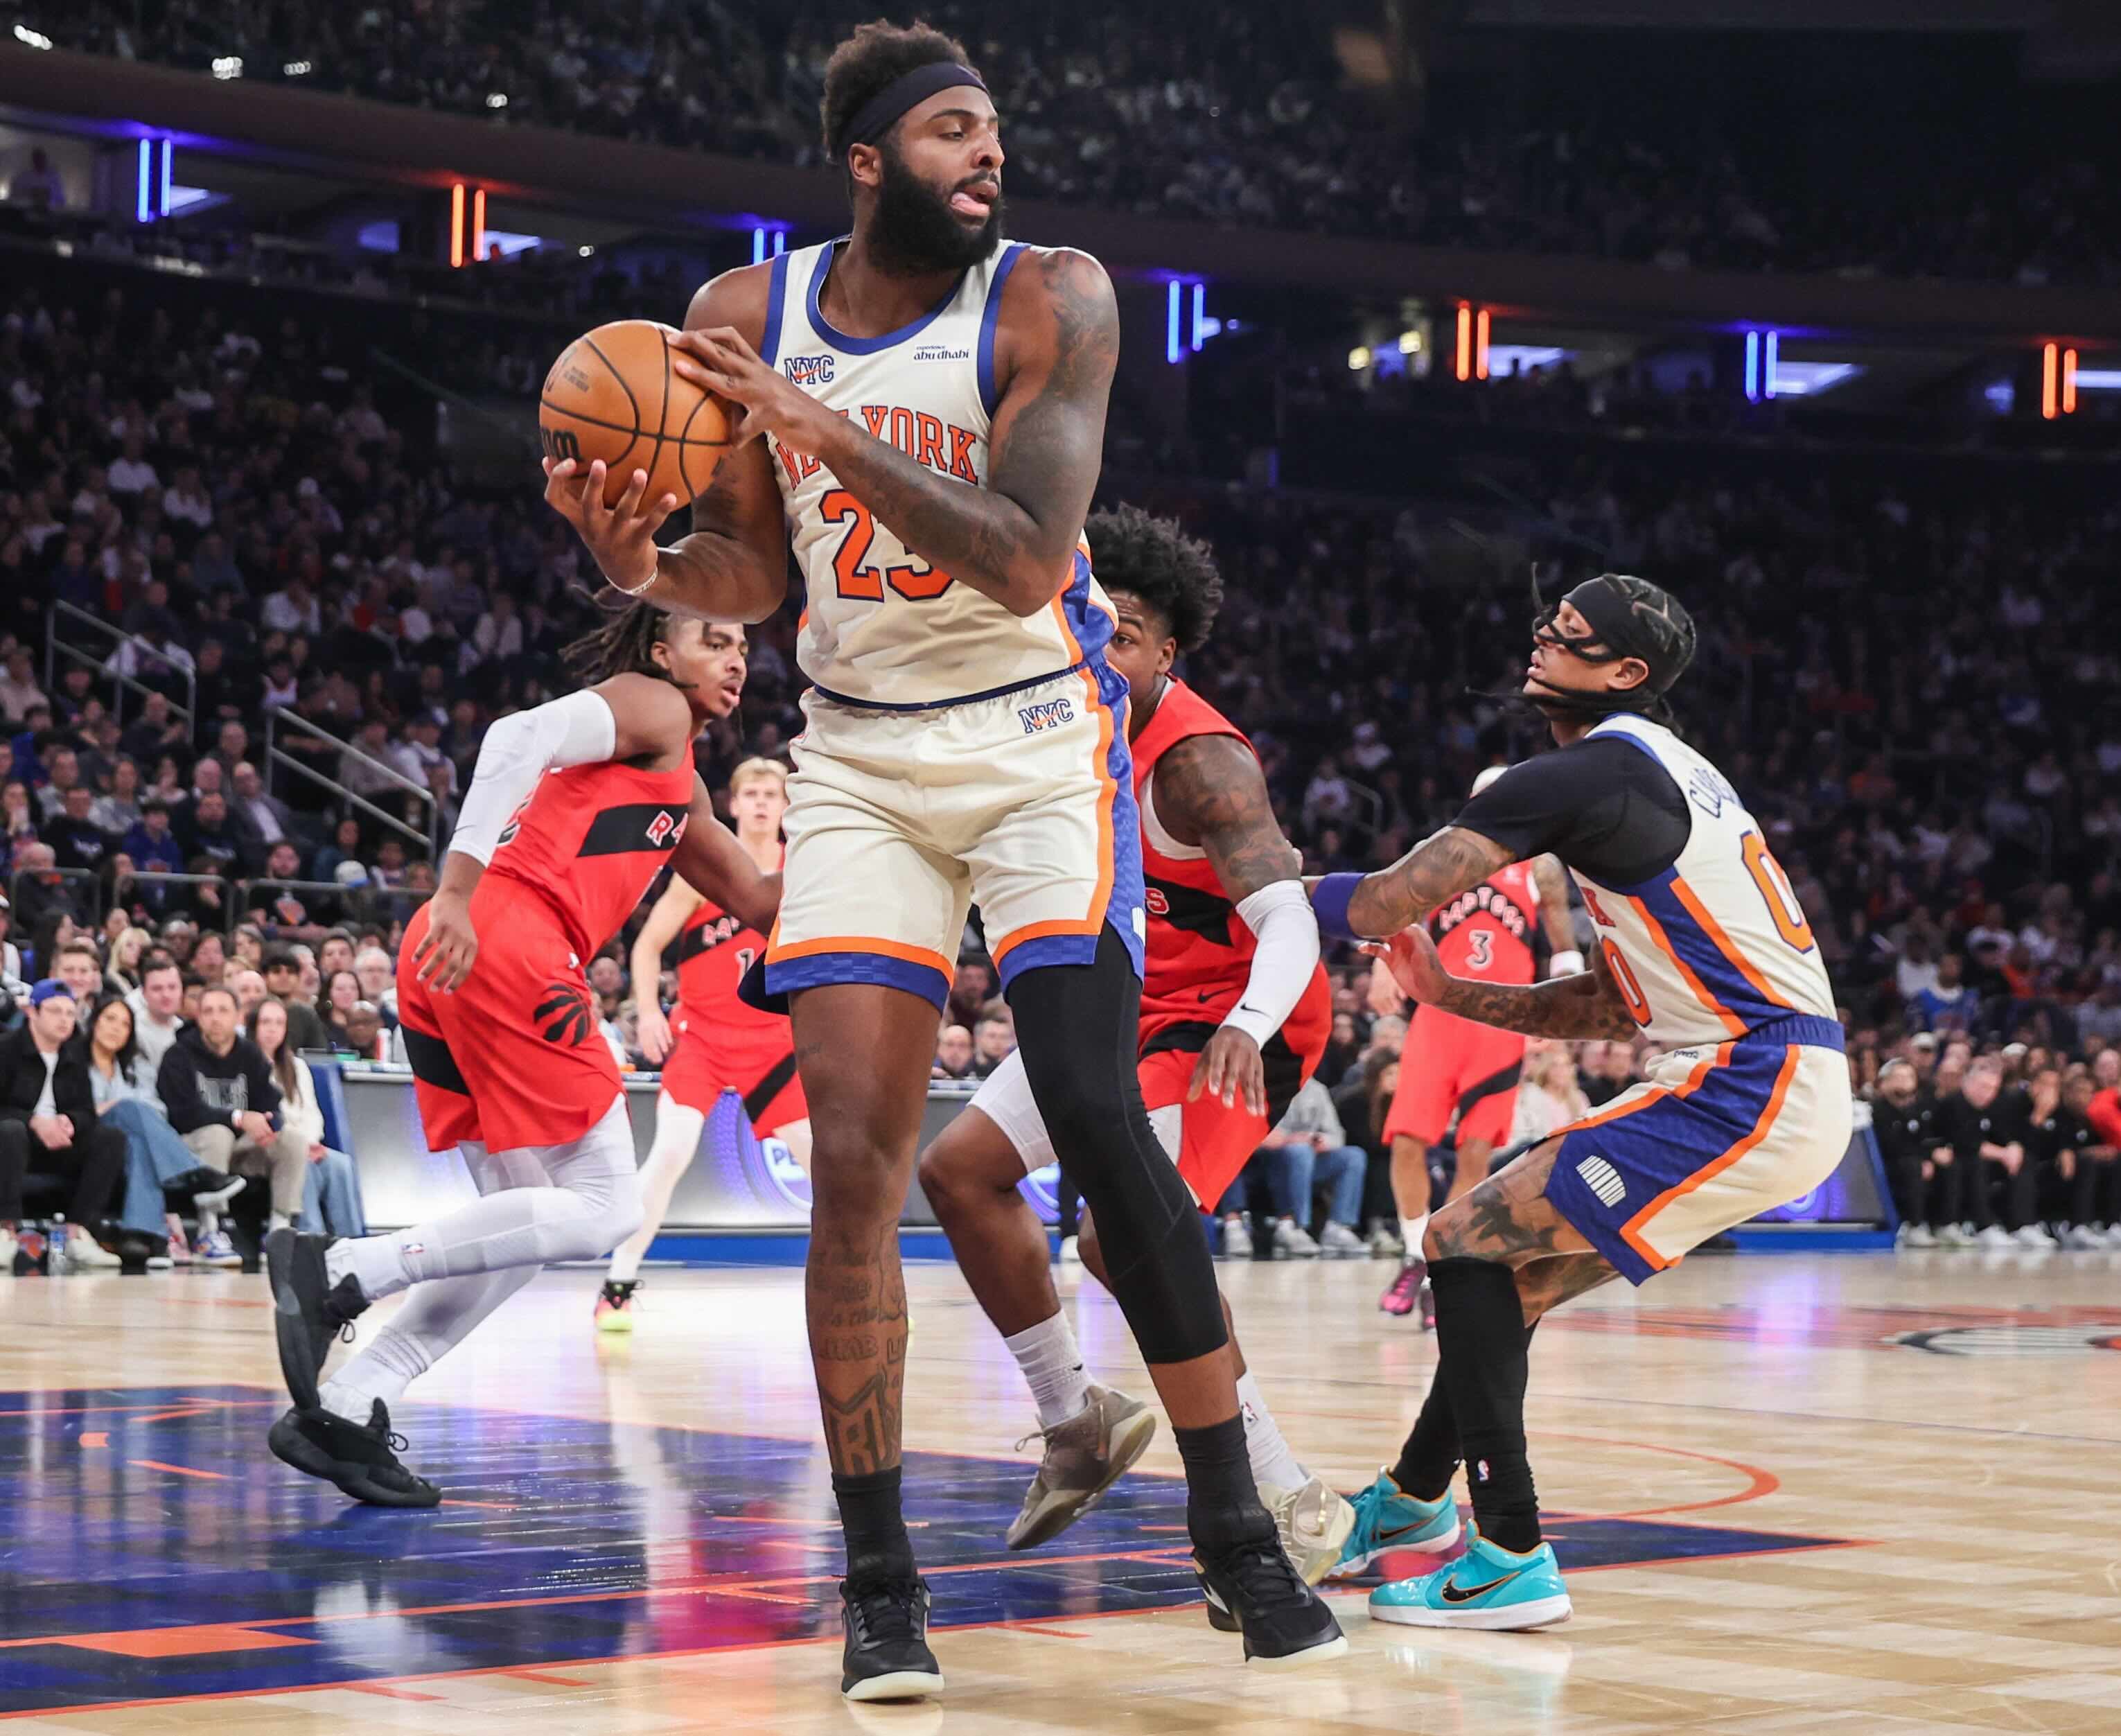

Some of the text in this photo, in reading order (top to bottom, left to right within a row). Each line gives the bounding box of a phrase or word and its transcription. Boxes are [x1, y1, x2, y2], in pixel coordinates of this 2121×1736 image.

[784, 355, 834, 385] NYC
[913, 349, 969, 360] abu dhabi
[861, 405, 978, 485] YORK
[1018, 699, 1074, 734] NYC
[1464, 929, 1496, 972] 3
